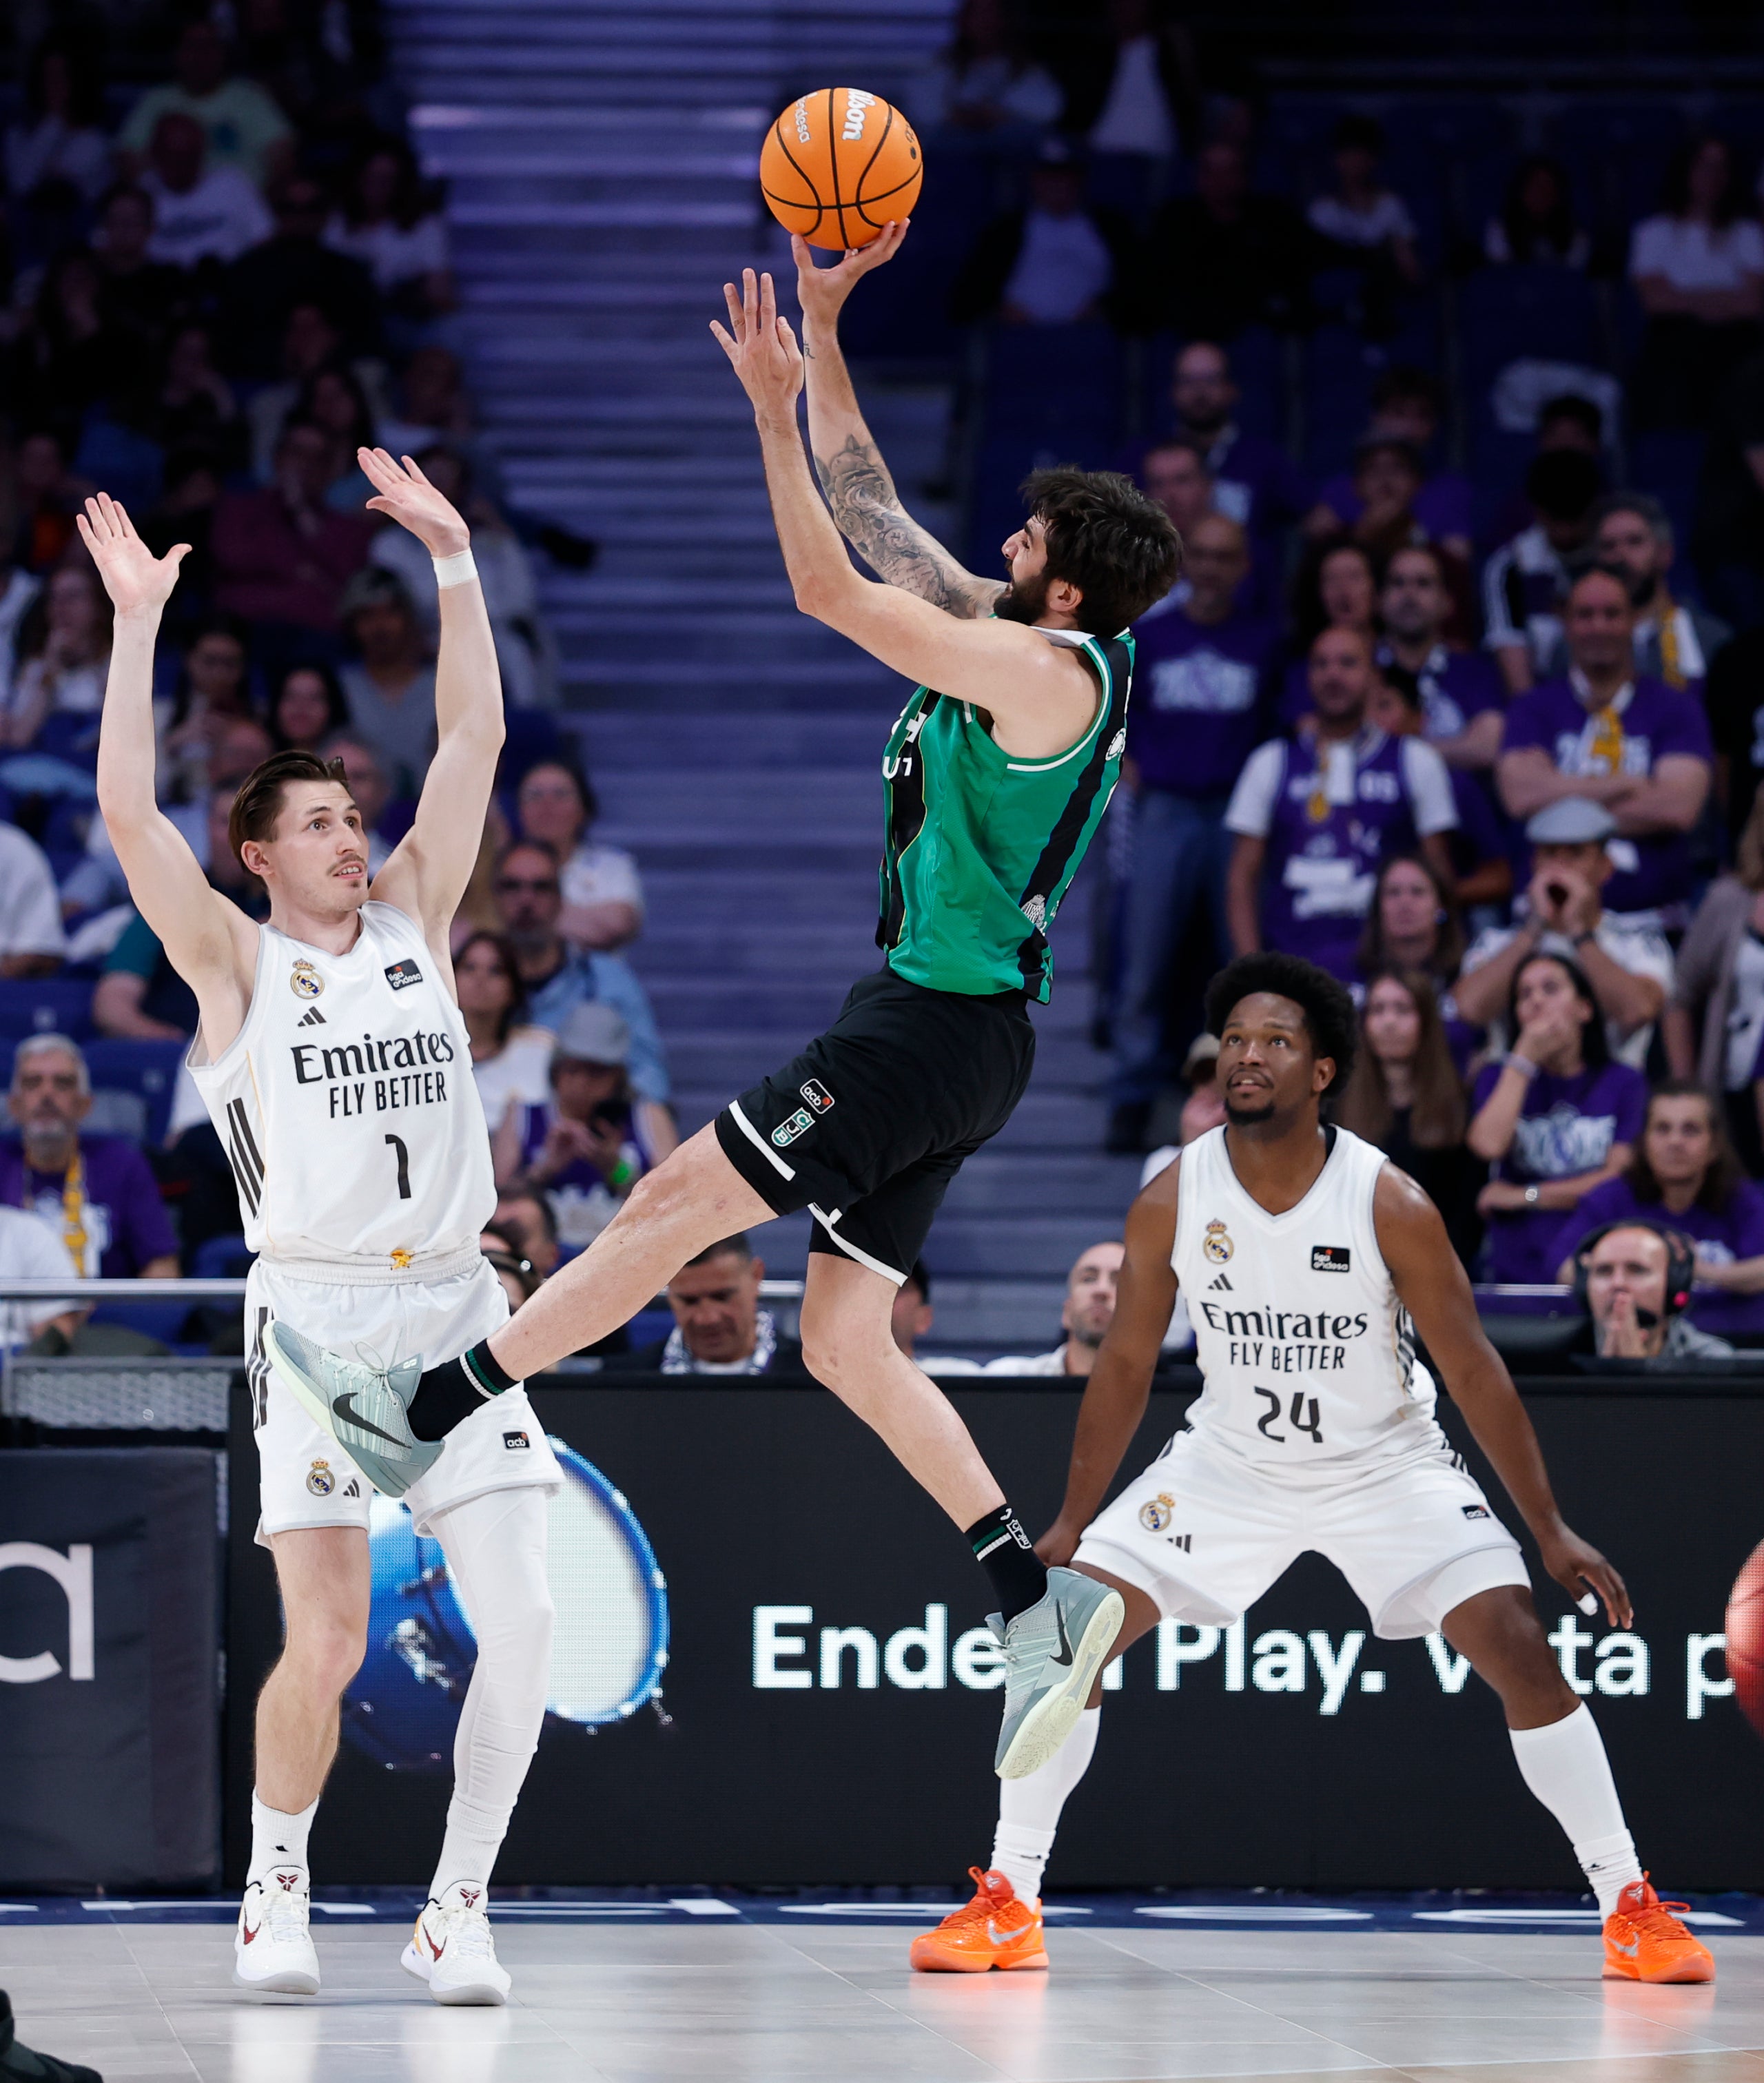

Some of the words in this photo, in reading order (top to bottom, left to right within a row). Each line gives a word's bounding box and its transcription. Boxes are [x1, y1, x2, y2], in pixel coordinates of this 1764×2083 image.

[290, 1029, 454, 1085] Emirates
[329, 1082, 365, 1118] FLY
[375, 1071, 447, 1111] BETTER
[803, 1086, 822, 1107] acb
[384, 1133, 411, 1199] 1
[1200, 1301, 1368, 1340] Emirates
[1230, 1342, 1264, 1366] FLY
[1271, 1344, 1345, 1373] BETTER
[1254, 1386, 1323, 1443] 24
[506, 1437, 526, 1447] acb
[752, 1602, 1123, 1690] Ende
[1156, 1611, 1386, 1715] Play.
